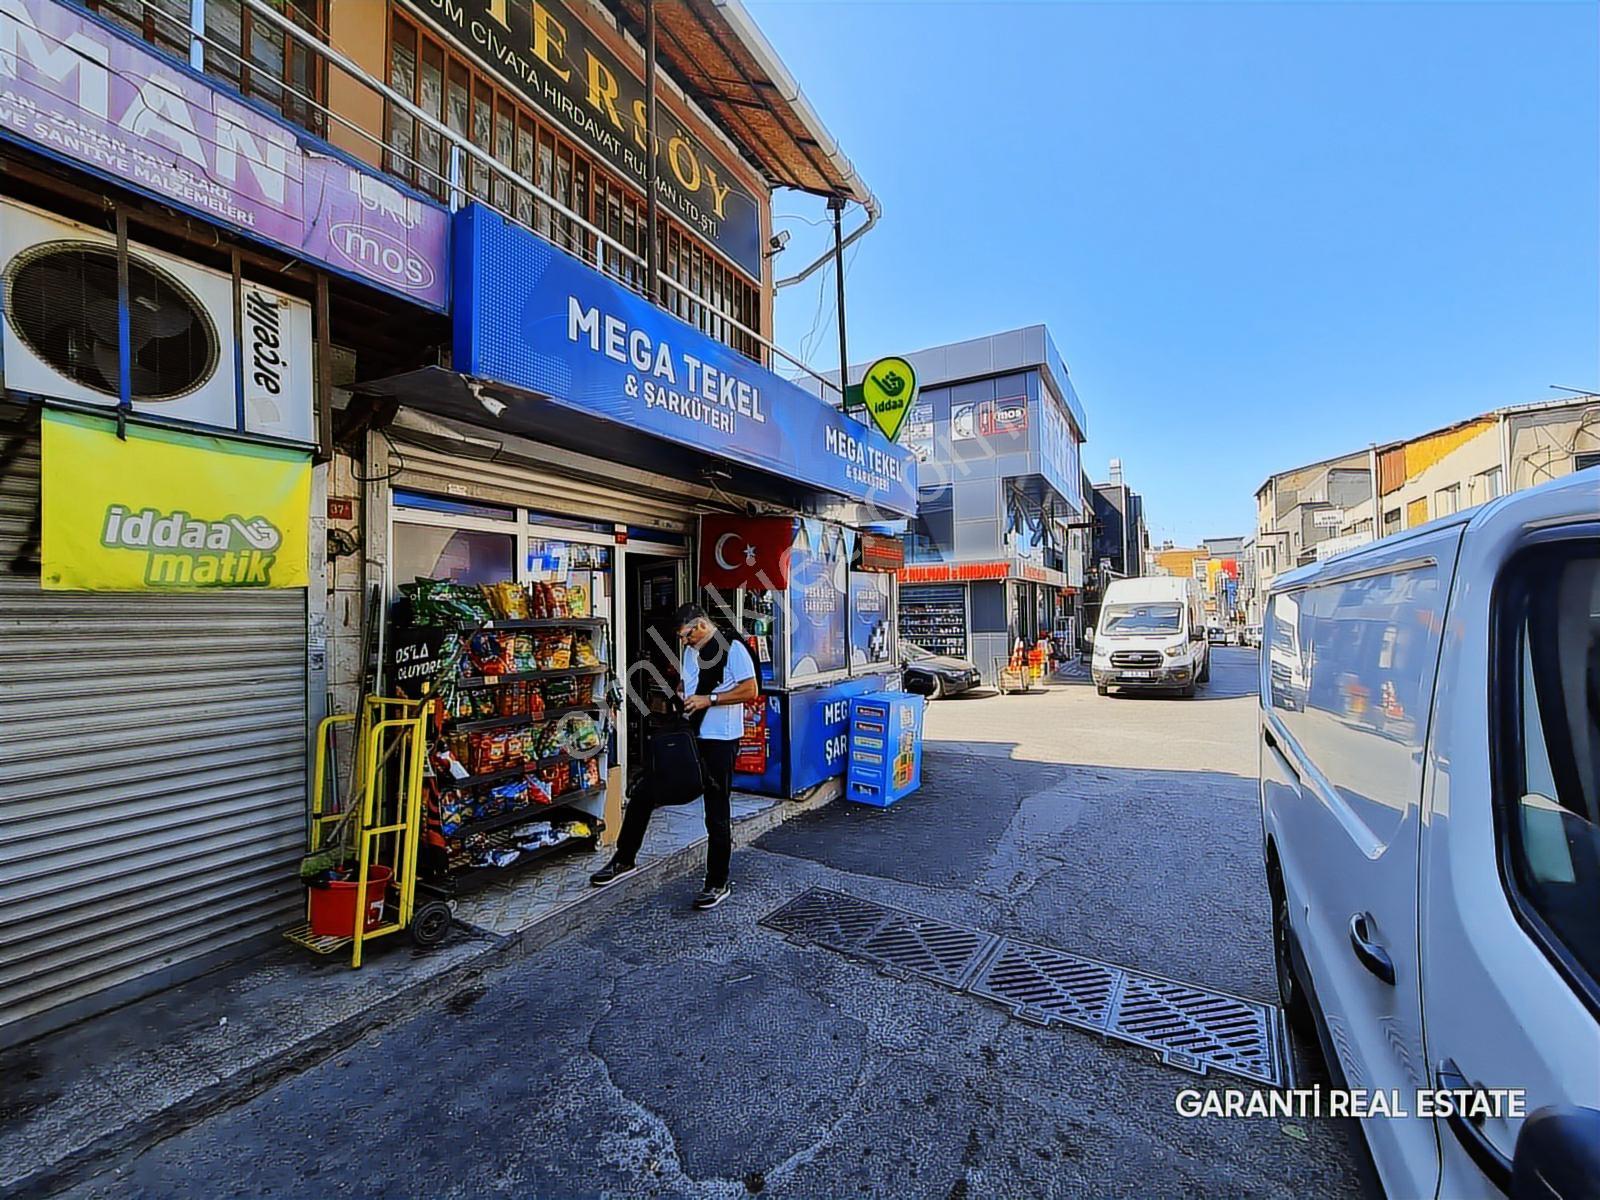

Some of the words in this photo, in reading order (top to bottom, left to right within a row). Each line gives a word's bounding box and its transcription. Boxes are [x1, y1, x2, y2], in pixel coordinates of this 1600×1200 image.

[544, 80, 622, 156] HIRDAVAT
[134, 162, 256, 227] MALZEMELERİ
[343, 228, 423, 283] mos
[246, 290, 287, 395] arçelik
[567, 294, 676, 384] MEGA
[683, 353, 766, 424] TEKEL
[624, 373, 639, 399] &
[643, 380, 736, 436] ŞARKÜTERİ
[874, 398, 904, 413] iddaa
[824, 424, 867, 468] MEGA
[867, 445, 903, 483] TEKEL
[103, 507, 233, 549] iddaa
[149, 550, 275, 584] matik
